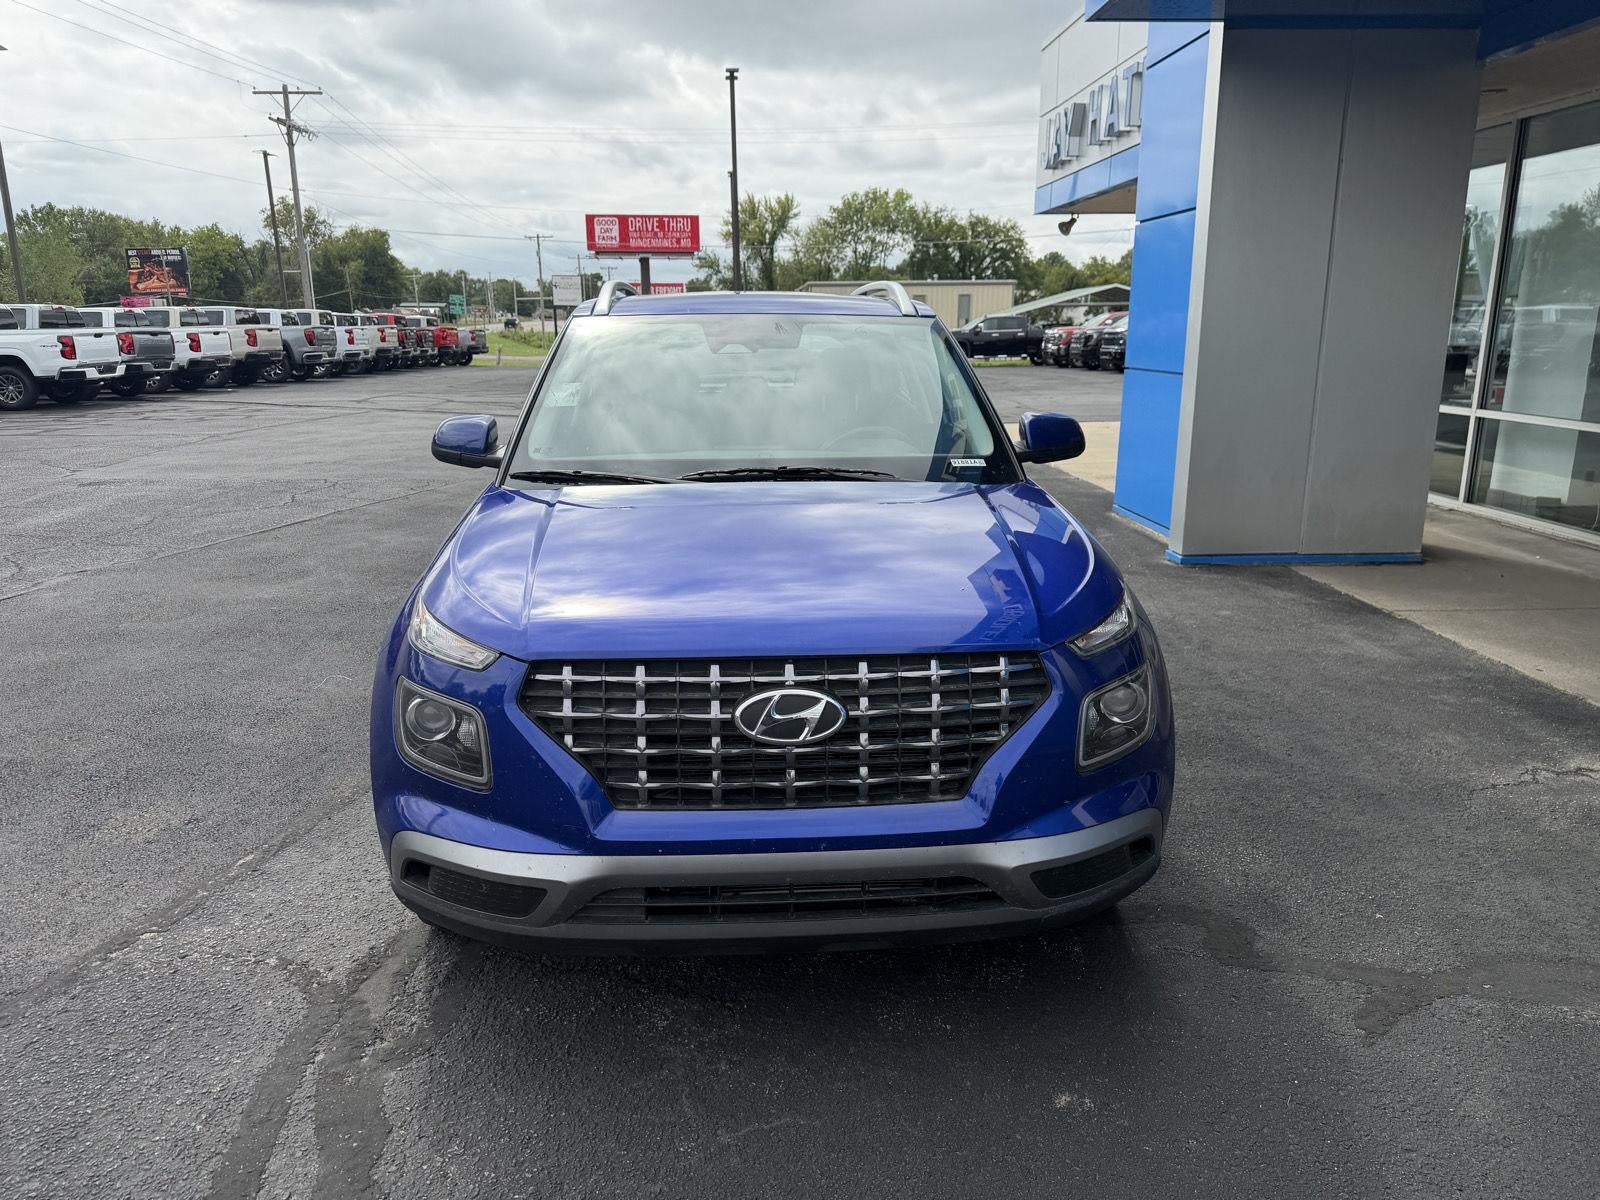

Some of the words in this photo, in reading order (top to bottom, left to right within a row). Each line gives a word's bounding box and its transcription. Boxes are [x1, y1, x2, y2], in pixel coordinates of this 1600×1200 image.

[628, 217, 659, 232] DRIVE
[664, 217, 691, 232] THRU
[680, 238, 691, 248] MO
